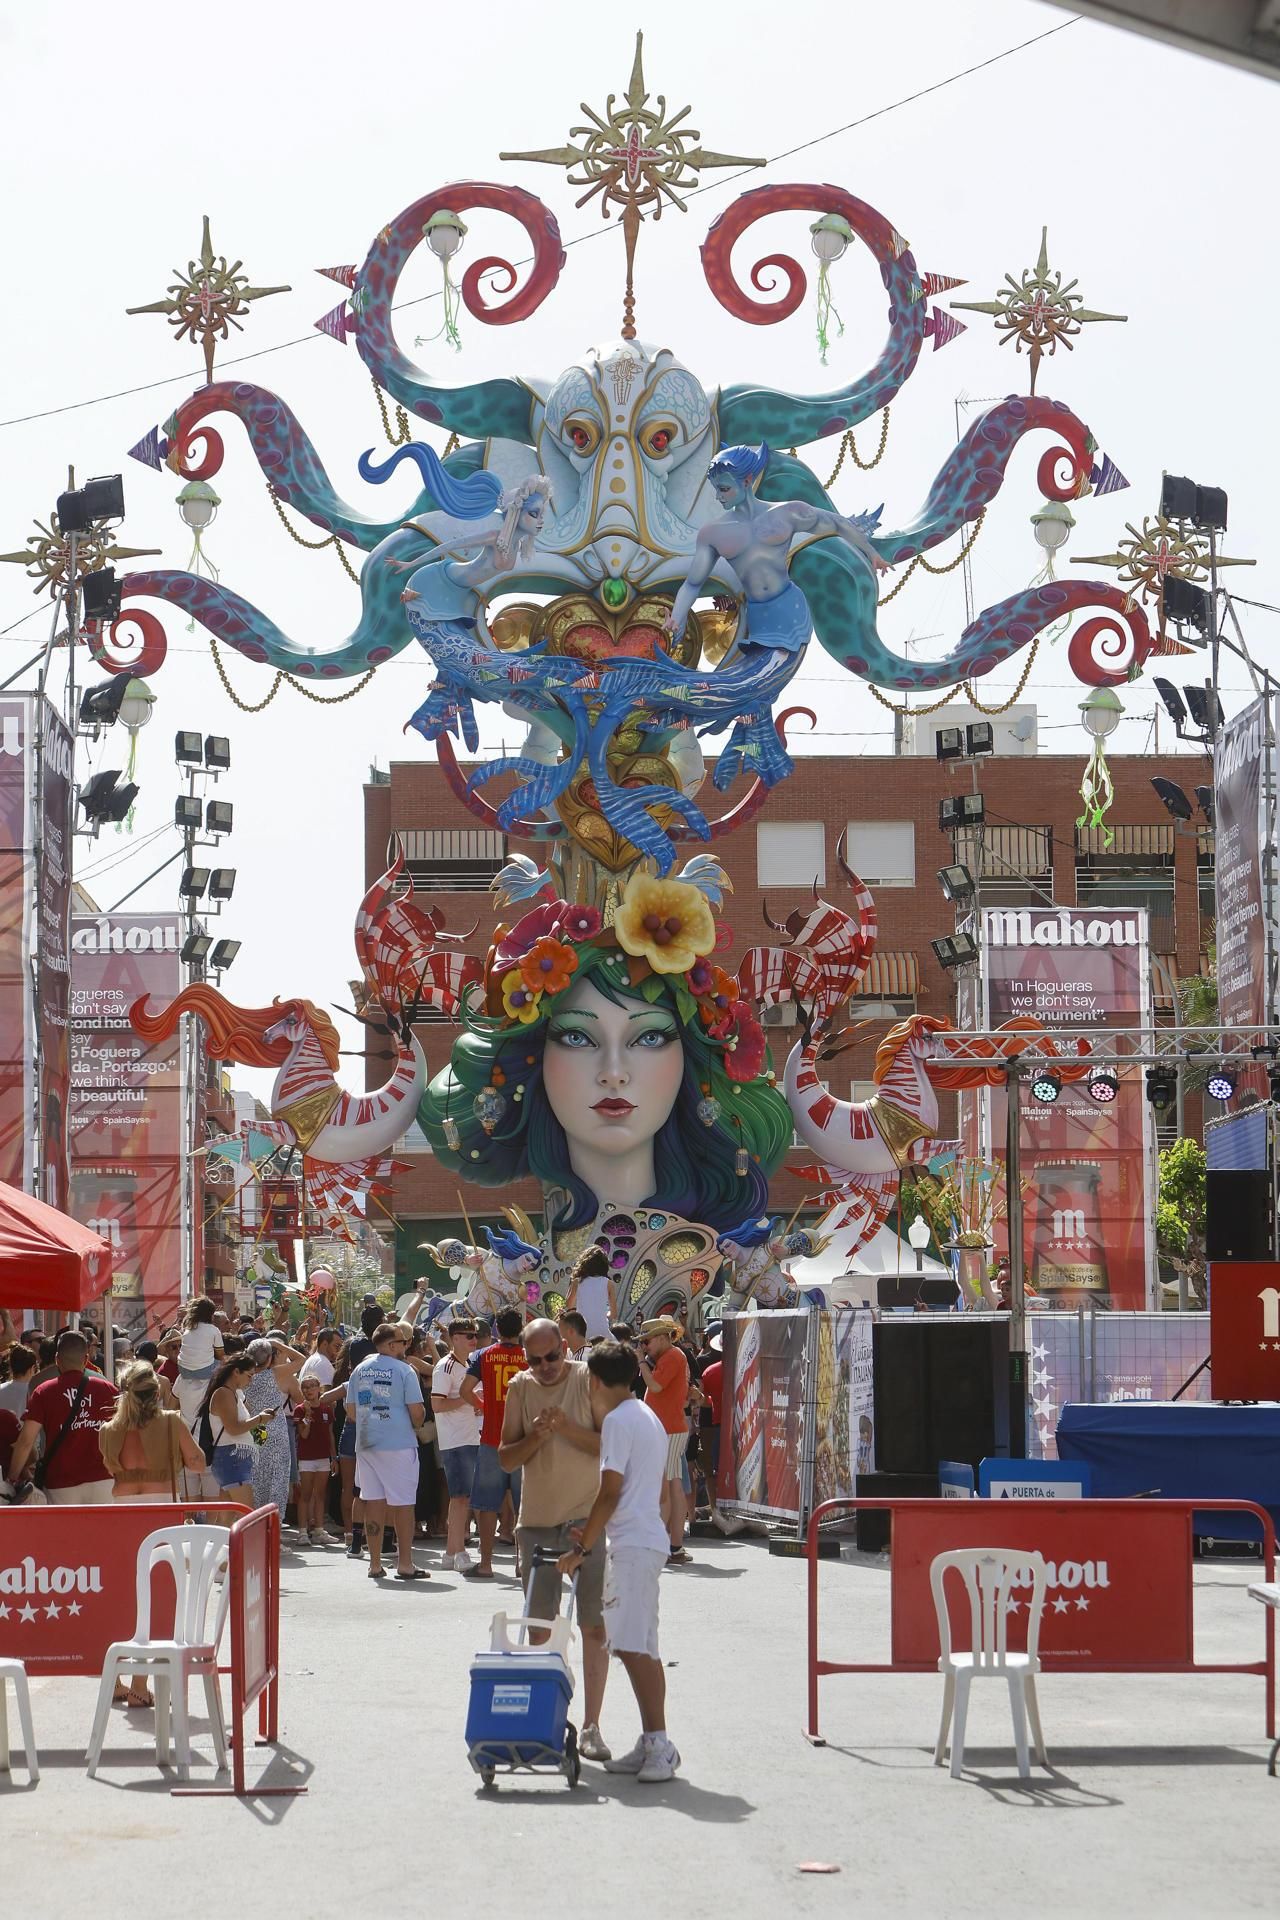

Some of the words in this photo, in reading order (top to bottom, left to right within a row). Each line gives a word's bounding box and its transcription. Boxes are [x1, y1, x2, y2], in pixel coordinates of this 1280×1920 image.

[988, 912, 1138, 946] Mahou
[72, 918, 178, 954] ahou
[1011, 981, 1023, 992] In
[1027, 980, 1093, 994] Hogueras
[71, 989, 124, 1002] ogueras
[1011, 997, 1033, 1006] we
[1036, 994, 1069, 1006] don't
[1073, 997, 1096, 1009] say
[102, 1004, 127, 1016] say
[81, 1046, 141, 1060] Foguera
[101, 1060, 176, 1074] Portazgo.”
[96, 1075, 129, 1087] think
[81, 1089, 148, 1101] beautiful.
[1021, 1106, 1052, 1115] Mahou
[71, 1115, 89, 1124] hou
[485, 1353, 509, 1363] LAMINE
[1012, 1487, 1043, 1498] PUERTA
[1046, 1489, 1055, 1498] de
[0, 1556, 104, 1594] ahou
